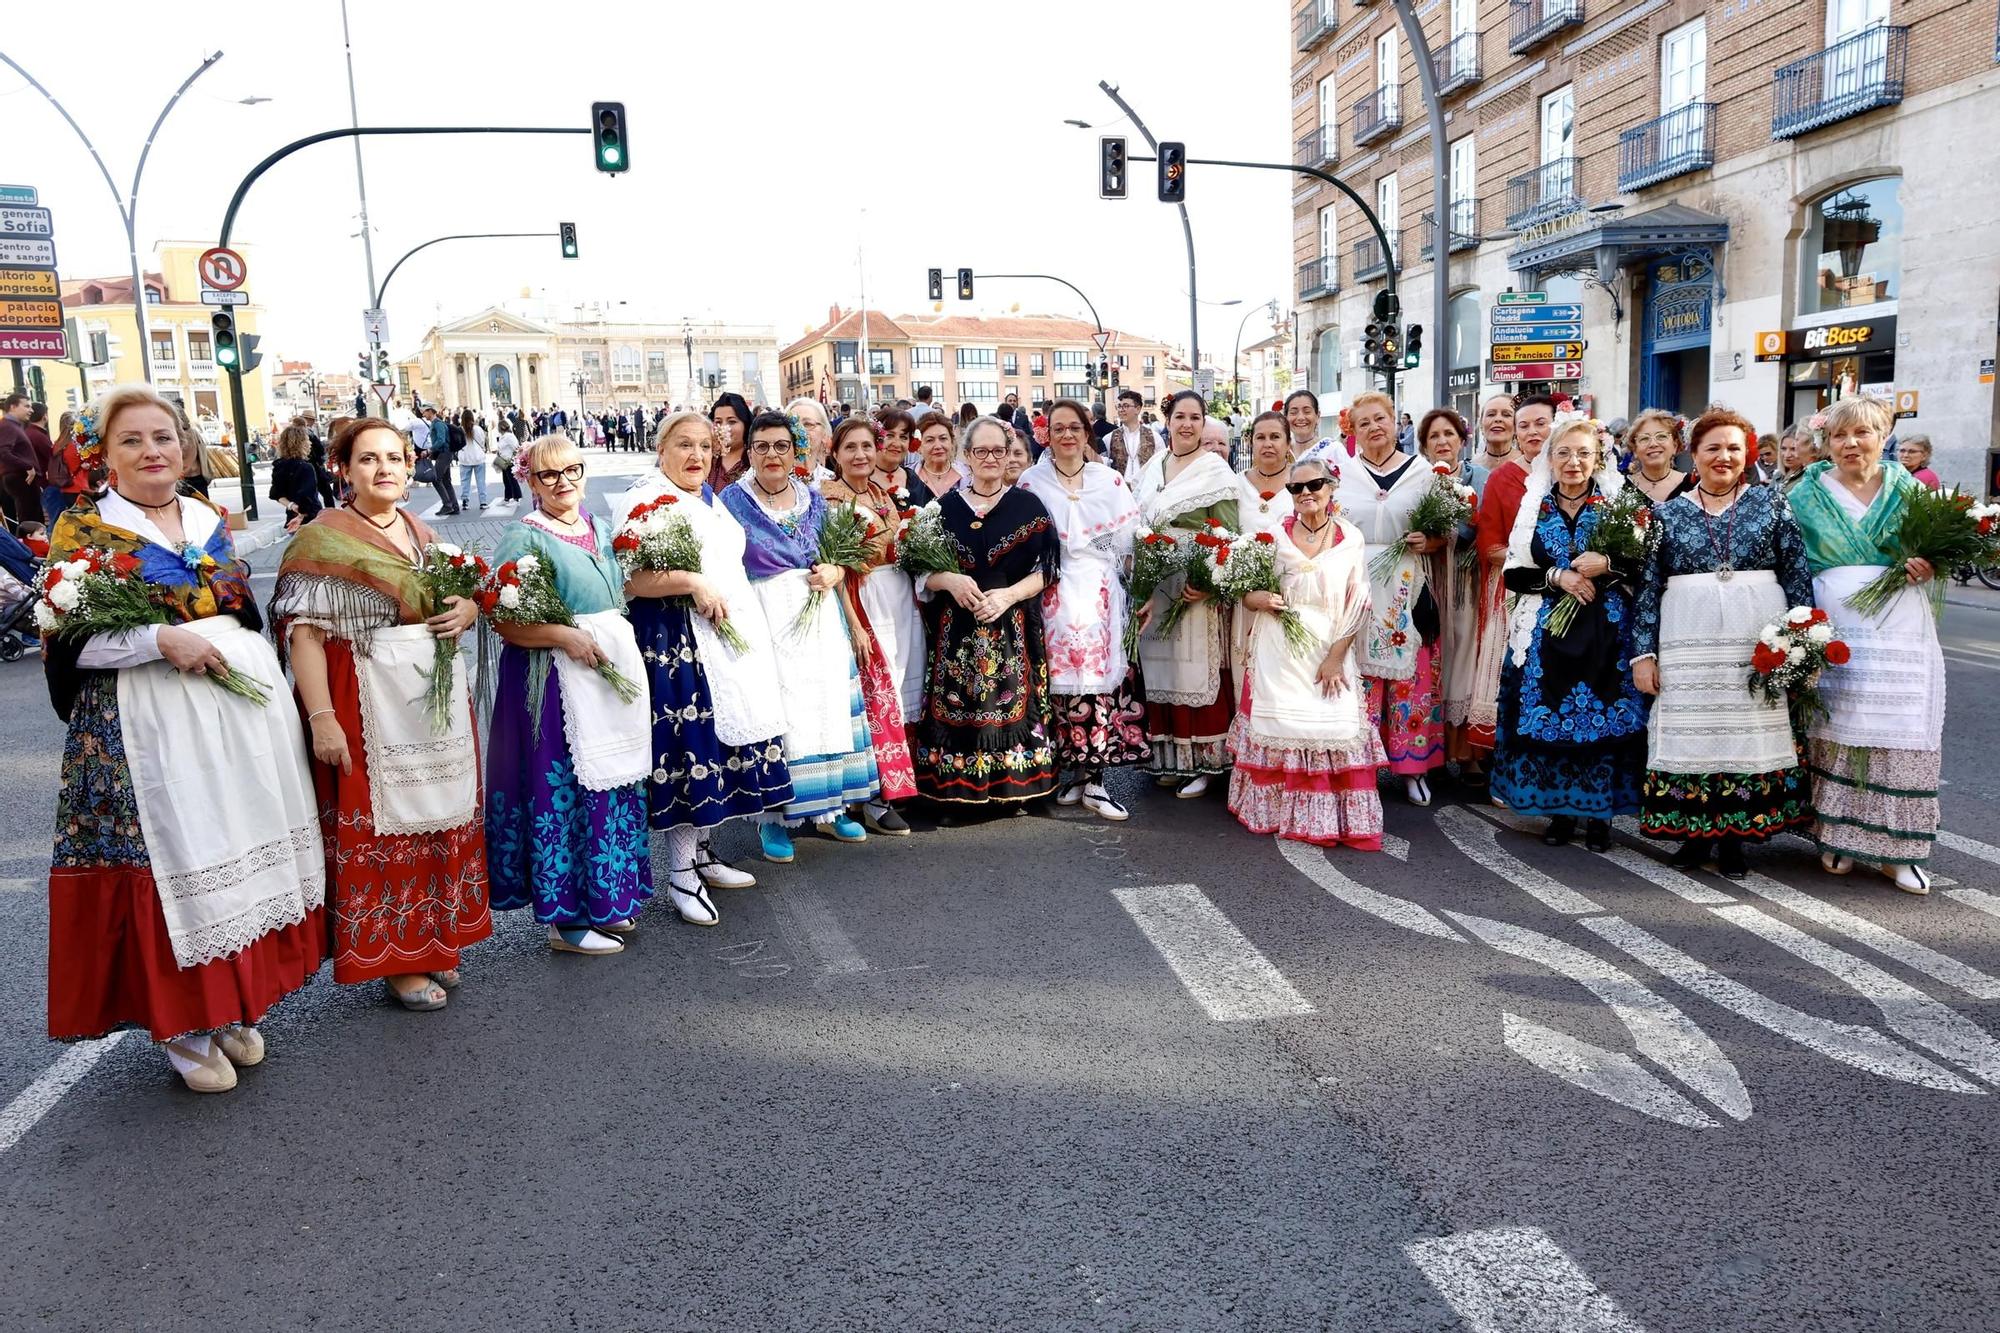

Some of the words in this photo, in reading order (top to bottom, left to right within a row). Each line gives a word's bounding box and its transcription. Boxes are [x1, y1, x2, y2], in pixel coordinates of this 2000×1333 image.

[1, 210, 47, 219] general
[1544, 211, 1586, 236] VICTORIA
[16, 254, 51, 262] sangre
[0, 271, 36, 280] itorio
[45, 273, 52, 283] y
[7, 302, 56, 312] palacio
[1494, 306, 1536, 316] Cartagena
[1, 313, 58, 324] deportes
[1494, 314, 1521, 322] Madrid
[1662, 311, 1701, 330] VICTORIA
[1494, 334, 1528, 342] Alicante
[1803, 326, 1871, 349] BitBase
[0, 338, 63, 350] atedral
[1514, 351, 1553, 360] Francisco
[1448, 372, 1476, 387] CIMAS
